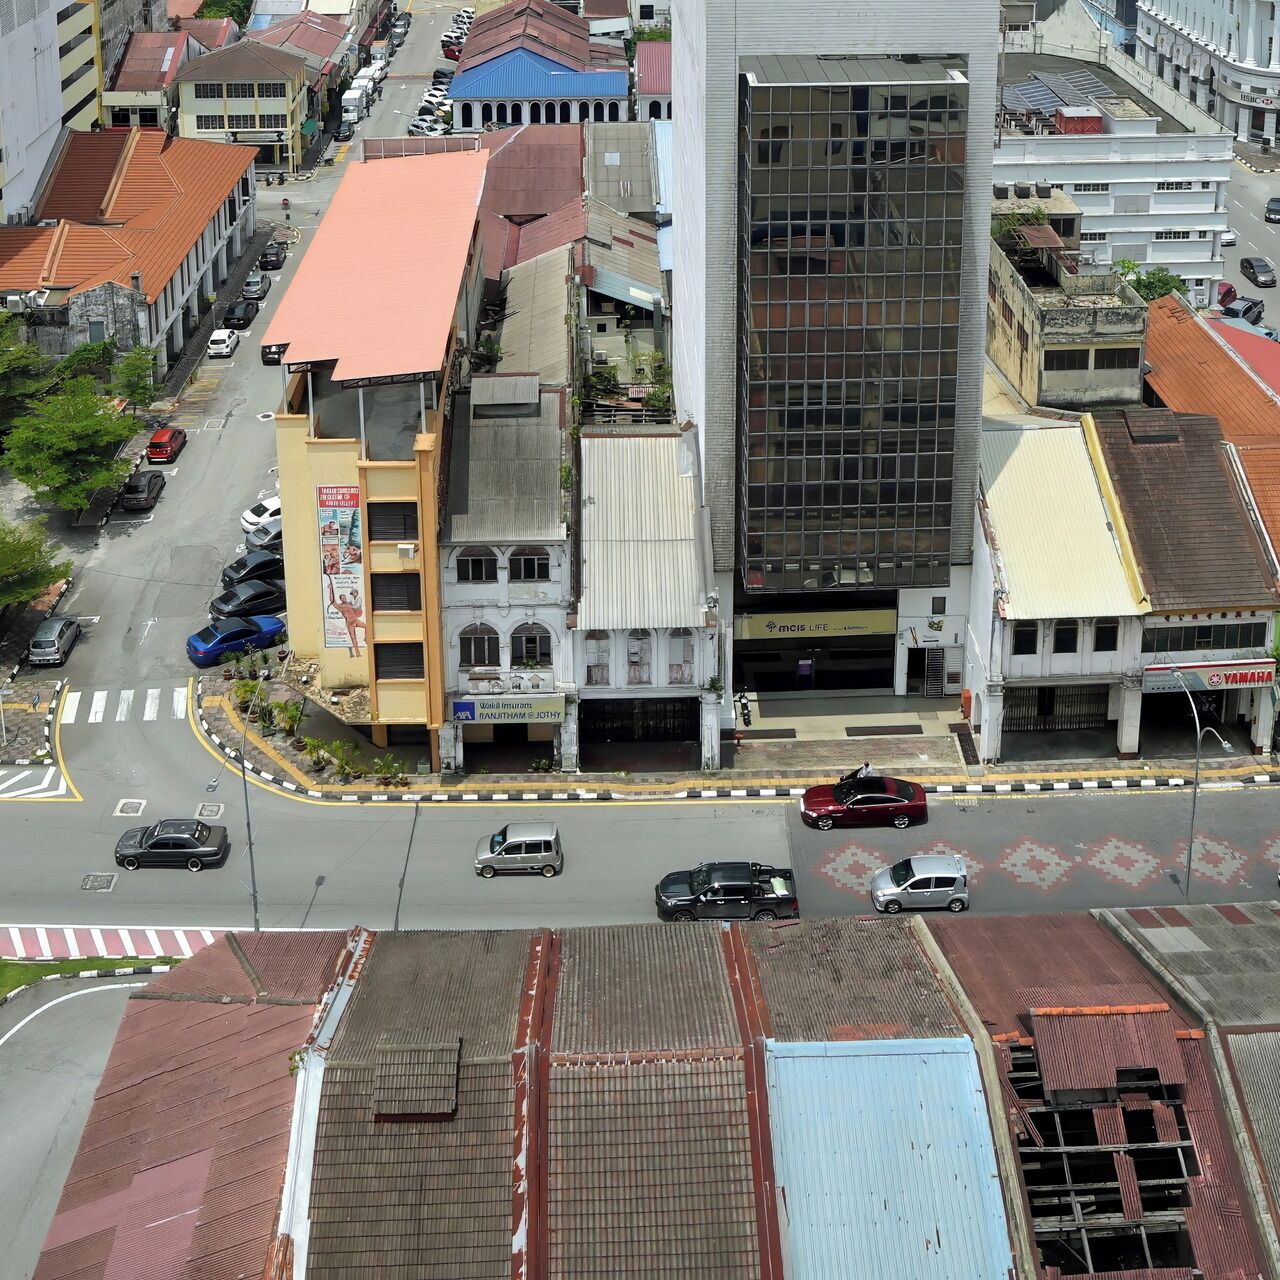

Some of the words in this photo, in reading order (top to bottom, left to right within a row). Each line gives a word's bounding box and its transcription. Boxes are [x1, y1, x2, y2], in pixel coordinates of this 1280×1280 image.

[809, 623, 829, 631] LIFE
[1224, 670, 1273, 685] YAMAHA
[480, 712, 526, 720] RANJITHAM
[535, 711, 561, 720] JOTHY
